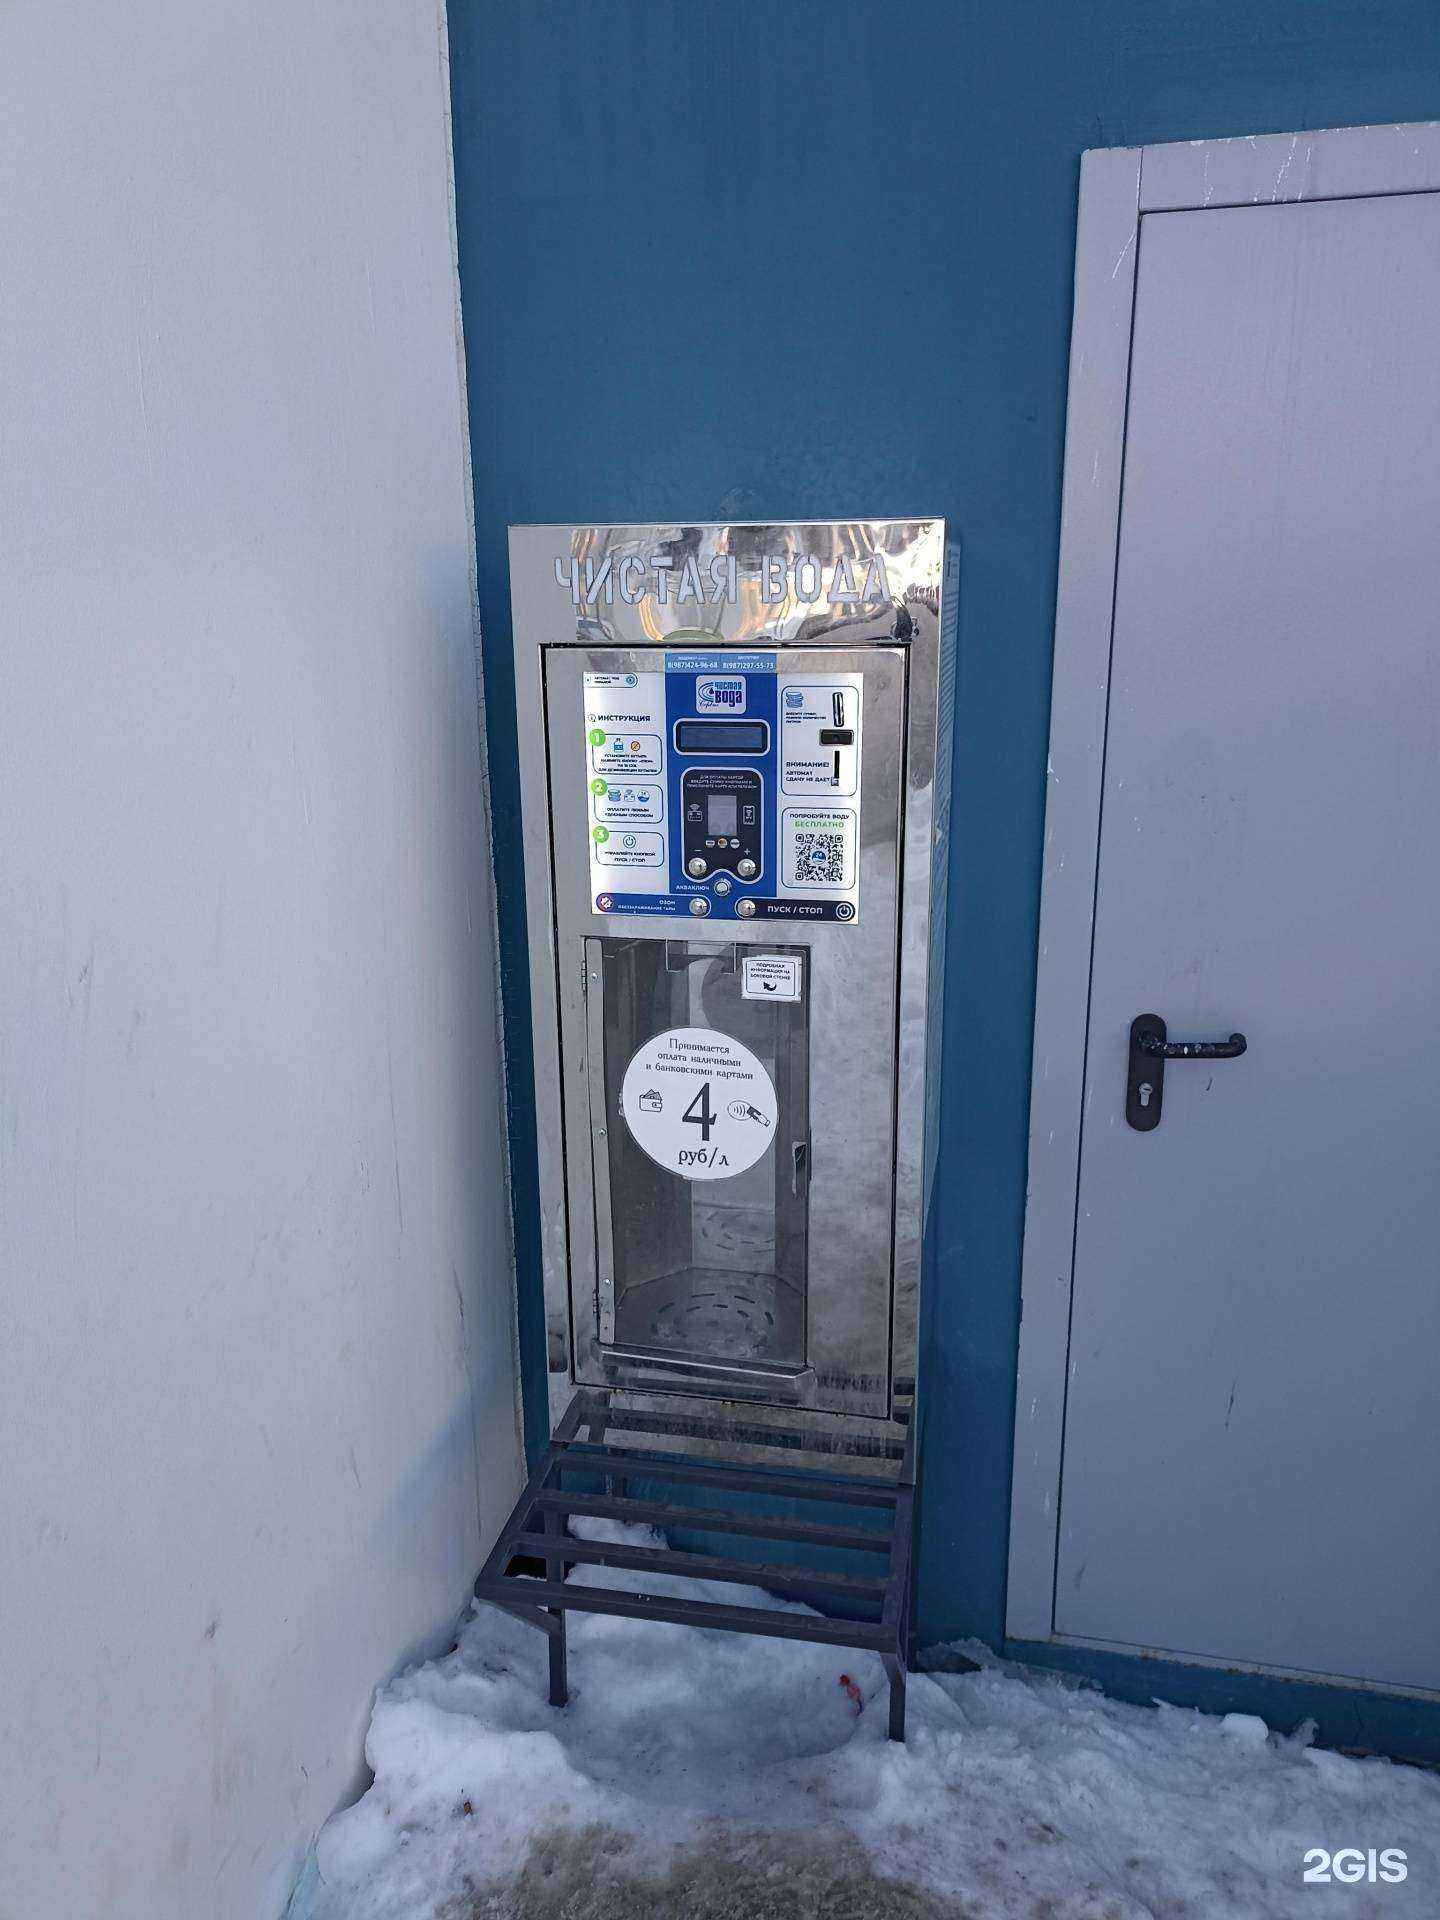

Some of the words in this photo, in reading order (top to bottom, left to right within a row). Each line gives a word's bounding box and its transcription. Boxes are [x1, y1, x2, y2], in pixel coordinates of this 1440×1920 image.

[554, 553, 737, 605] ЧИСТАЯ
[762, 553, 891, 604] ВОДА
[598, 714, 651, 723] ИНСТРУКЦИЯ
[790, 812, 831, 820] ПОПРОБУЙТЕ
[795, 820, 845, 828] БЕСПЛАТНО
[767, 905, 792, 914] ПУСК
[798, 906, 823, 914] СТОП
[669, 1038, 730, 1054] Принимается
[657, 1052, 687, 1062] оплата
[691, 1056, 741, 1067] наличными
[655, 1062, 713, 1076] банковскими
[716, 1070, 754, 1080] картами
[681, 1082, 718, 1141] 4
[678, 1147, 730, 1168] руб/л
